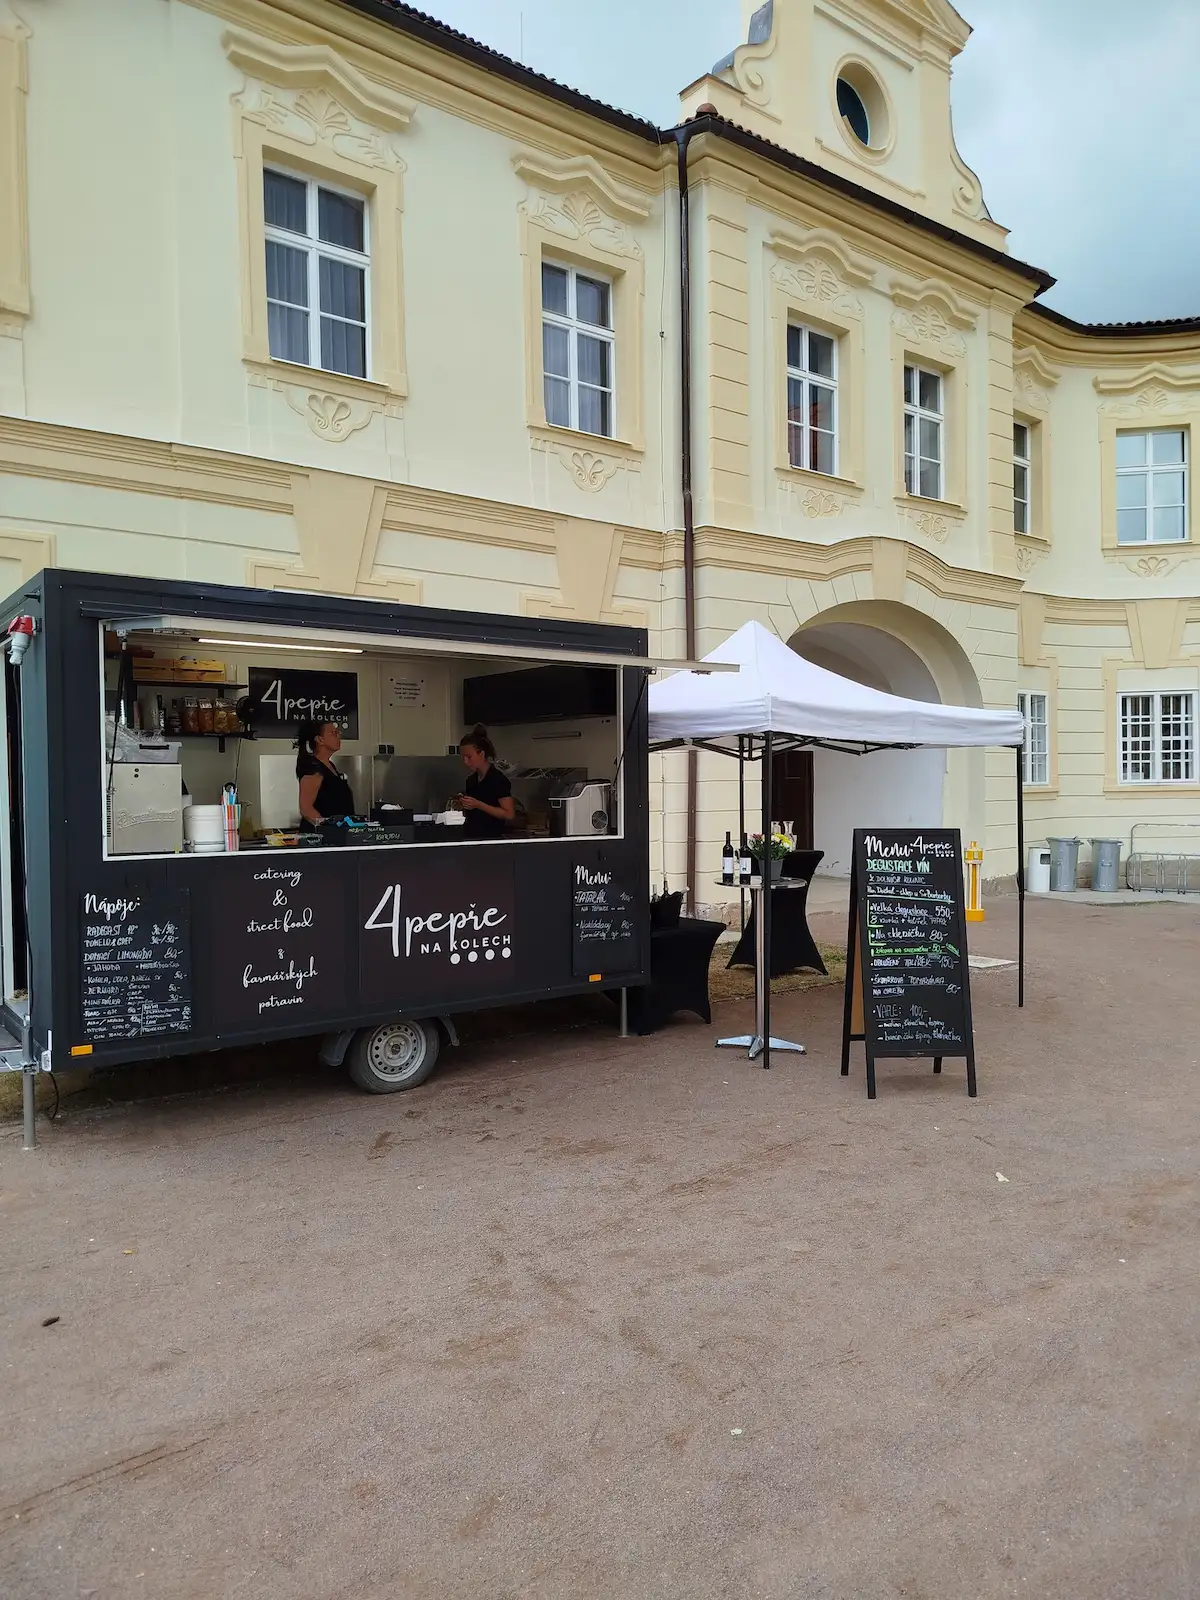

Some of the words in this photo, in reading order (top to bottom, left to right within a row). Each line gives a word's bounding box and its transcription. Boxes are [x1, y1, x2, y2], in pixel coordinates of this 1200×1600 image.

[260, 680, 345, 721] 4pepře
[293, 713, 306, 721] NA
[311, 714, 348, 722] KOLECH
[863, 835, 914, 858] Menu:
[574, 864, 612, 885] Menu:
[866, 858, 913, 873] DEGUSTACE
[916, 856, 930, 873] VÍN
[253, 867, 303, 887] catering
[272, 889, 288, 907] &
[576, 888, 607, 904] TATARÁK
[83, 892, 141, 921] Nápoje:
[246, 917, 283, 933] street
[283, 907, 315, 933] food
[364, 883, 508, 958] 4pepře
[86, 924, 122, 938] RADEGAST
[875, 928, 886, 939] Na
[887, 926, 926, 940] skleničku
[420, 942, 442, 954] NA
[450, 933, 511, 952] KOLECH
[277, 948, 285, 960] z
[92, 963, 121, 972] JAHODA
[243, 955, 319, 990] farmářských
[258, 994, 304, 1014] potravin
